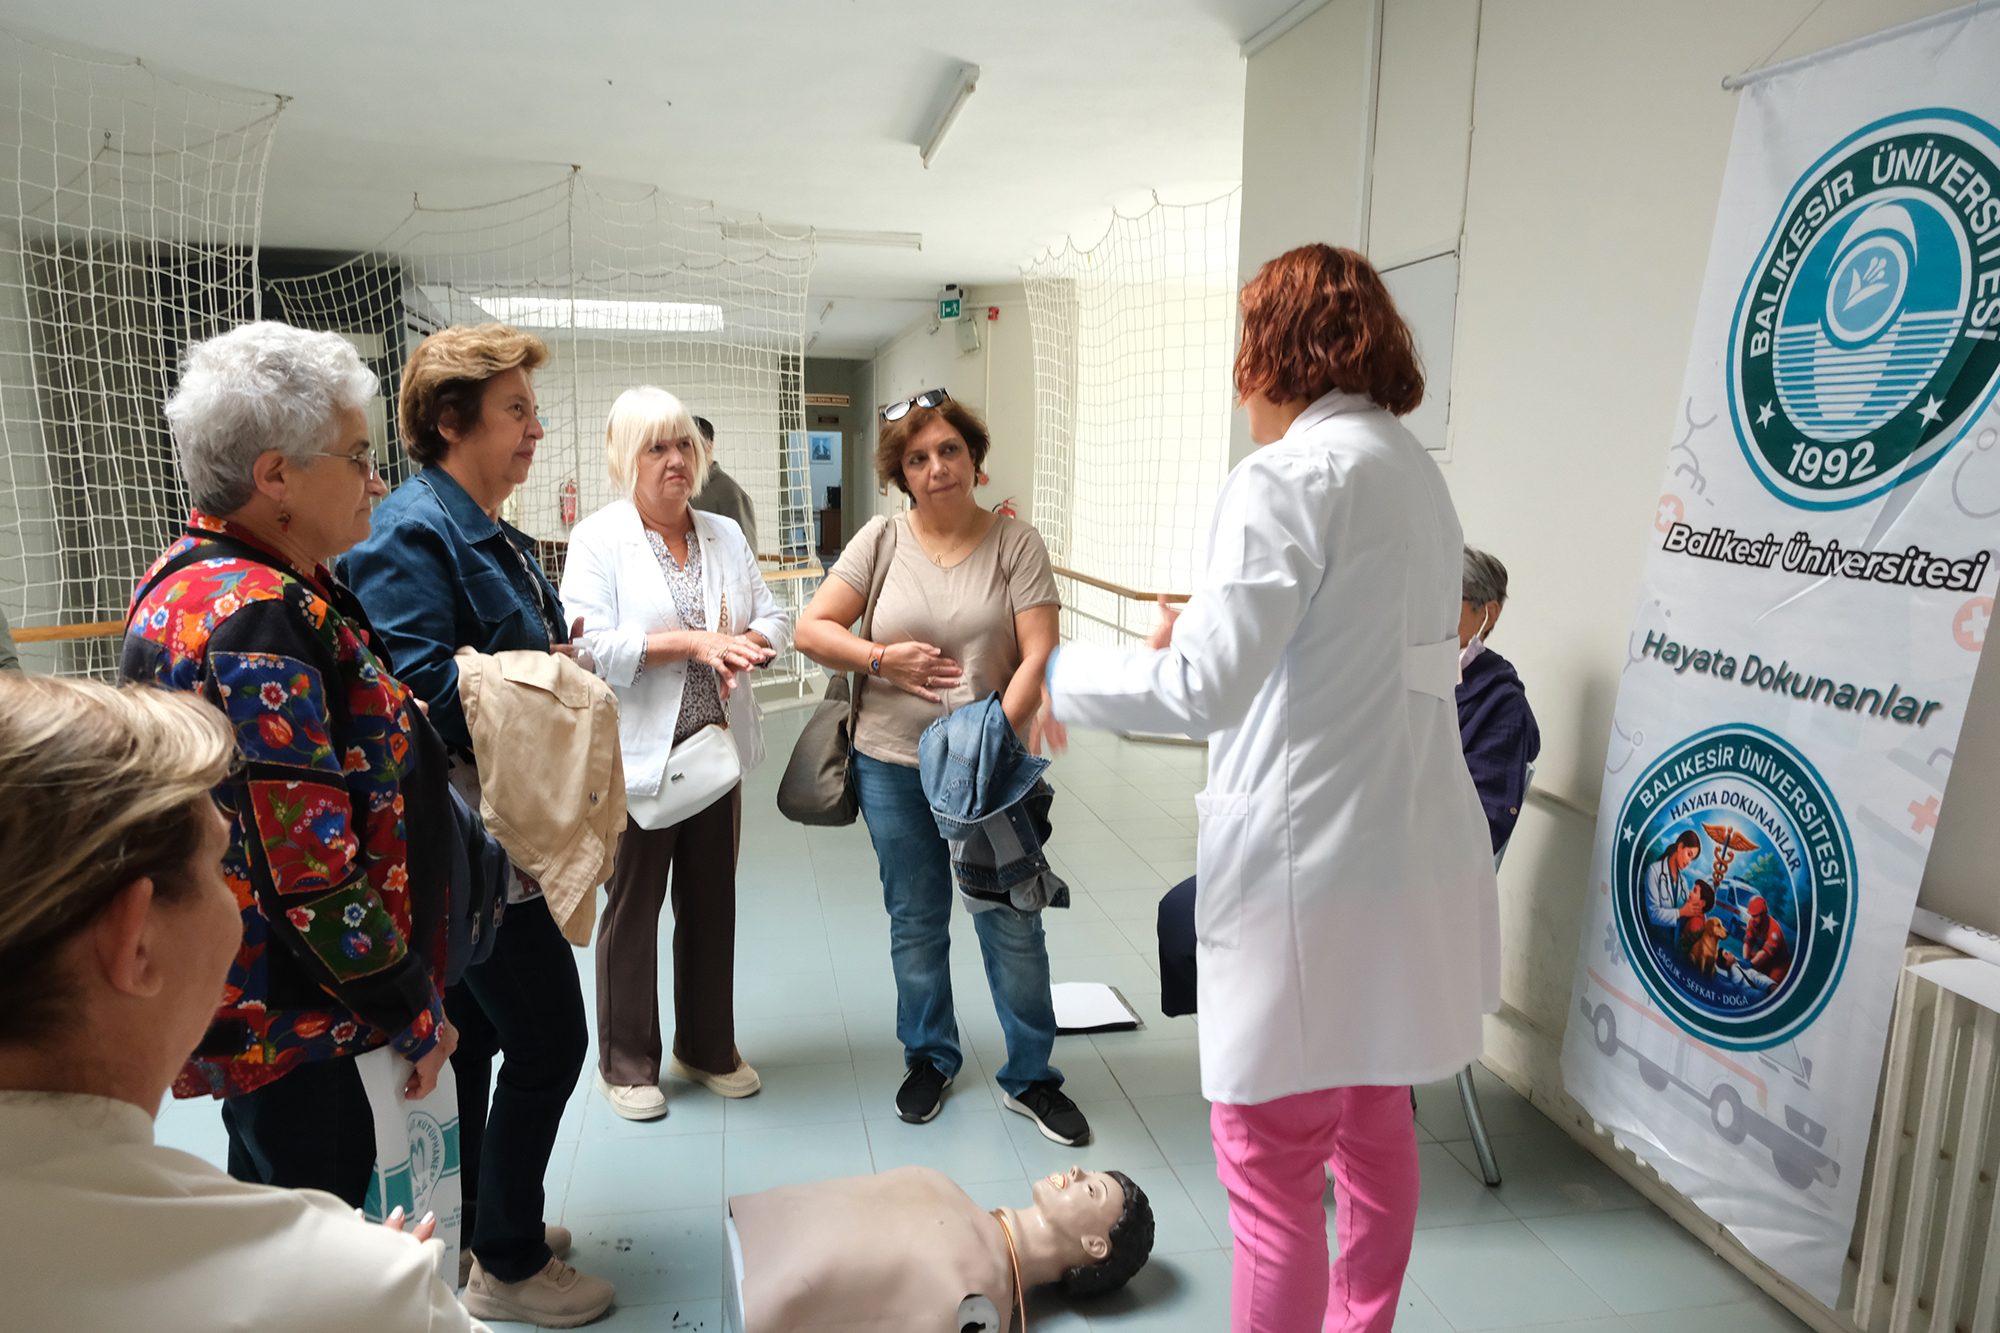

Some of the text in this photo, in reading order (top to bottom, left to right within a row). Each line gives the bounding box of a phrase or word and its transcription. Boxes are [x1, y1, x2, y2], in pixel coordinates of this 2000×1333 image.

[1750, 170, 1855, 358] BALIKESİR
[1787, 440, 1877, 485] 1992
[1663, 522, 1991, 592] Balıkesir Üniversitesi
[1641, 629, 1942, 726] Hayata Dokunanlar
[1639, 743, 1846, 887] BALIKESİR ÜNİVERSİTESİ
[1670, 790, 1801, 873] HAYATA DOKUNANLAR
